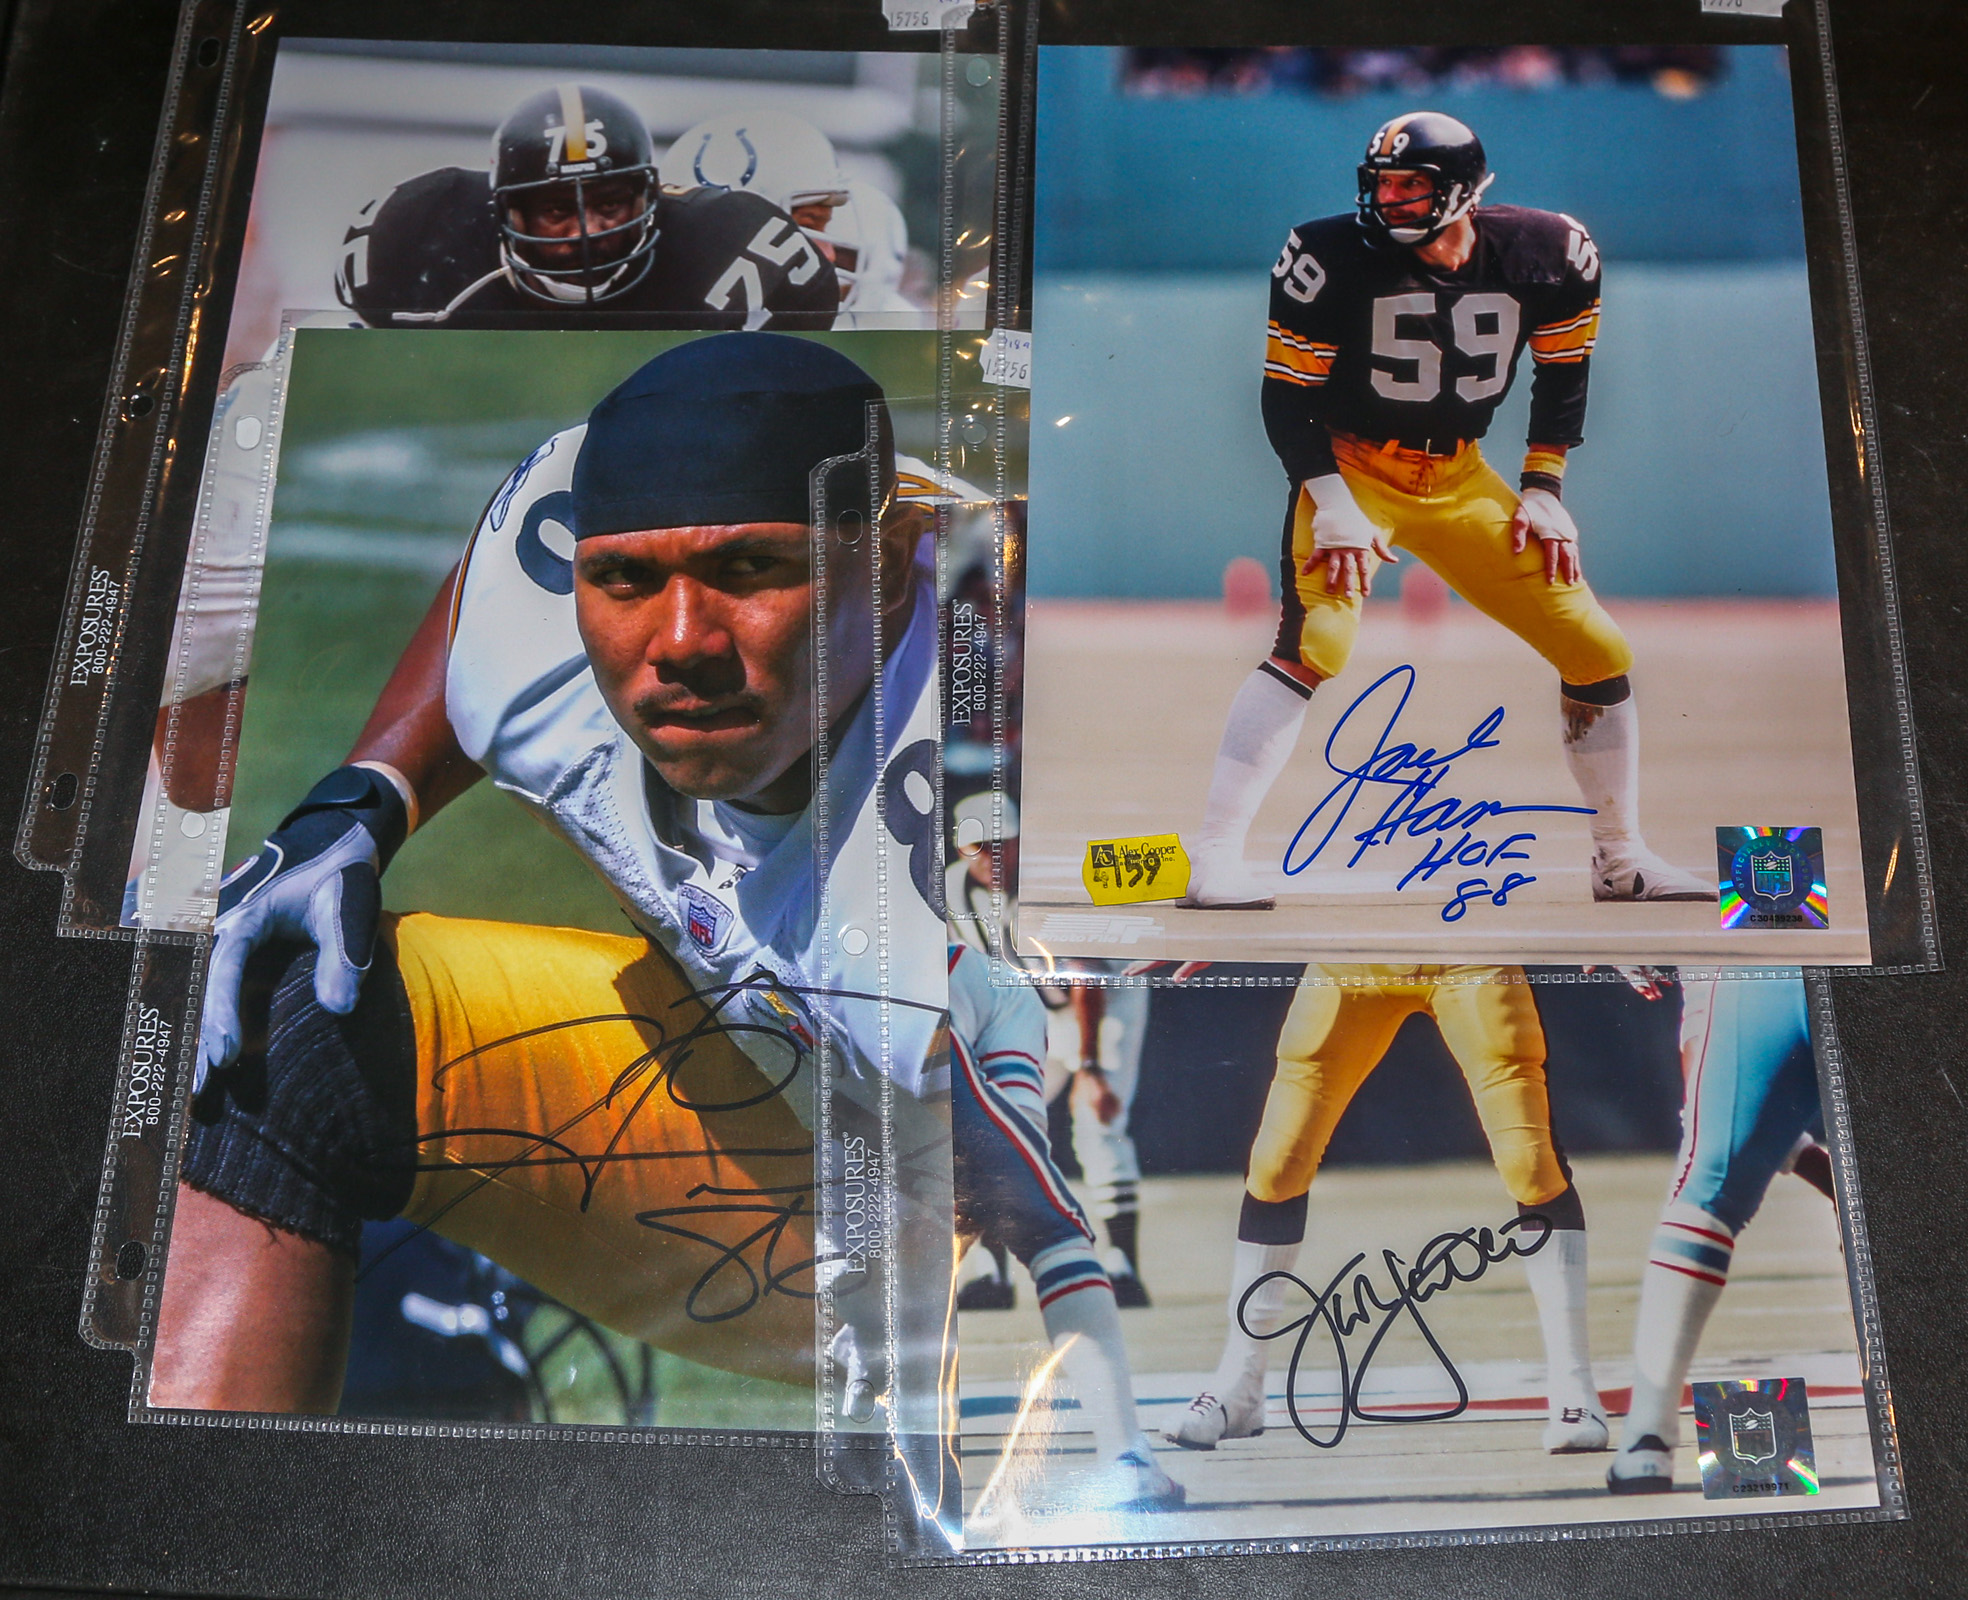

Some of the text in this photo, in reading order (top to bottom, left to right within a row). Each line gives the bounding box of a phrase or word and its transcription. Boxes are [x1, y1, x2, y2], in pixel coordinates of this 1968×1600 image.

[889, 11, 929, 28] 15756
[544, 120, 608, 162] 75
[1369, 132, 1410, 157] 59
[704, 216, 821, 331] 75
[1272, 228, 1327, 304] 59
[1370, 292, 1522, 403] 59
[92, 580, 121, 674] 800-222-4947
[973, 613, 988, 711] 800-222-4947
[1140, 842, 1177, 857] Cooper
[1396, 832, 1537, 891] HOF
[1442, 873, 1537, 922] 88
[146, 1020, 173, 1125] 800-222-4947
[867, 1149, 881, 1259] 800-222-4947
